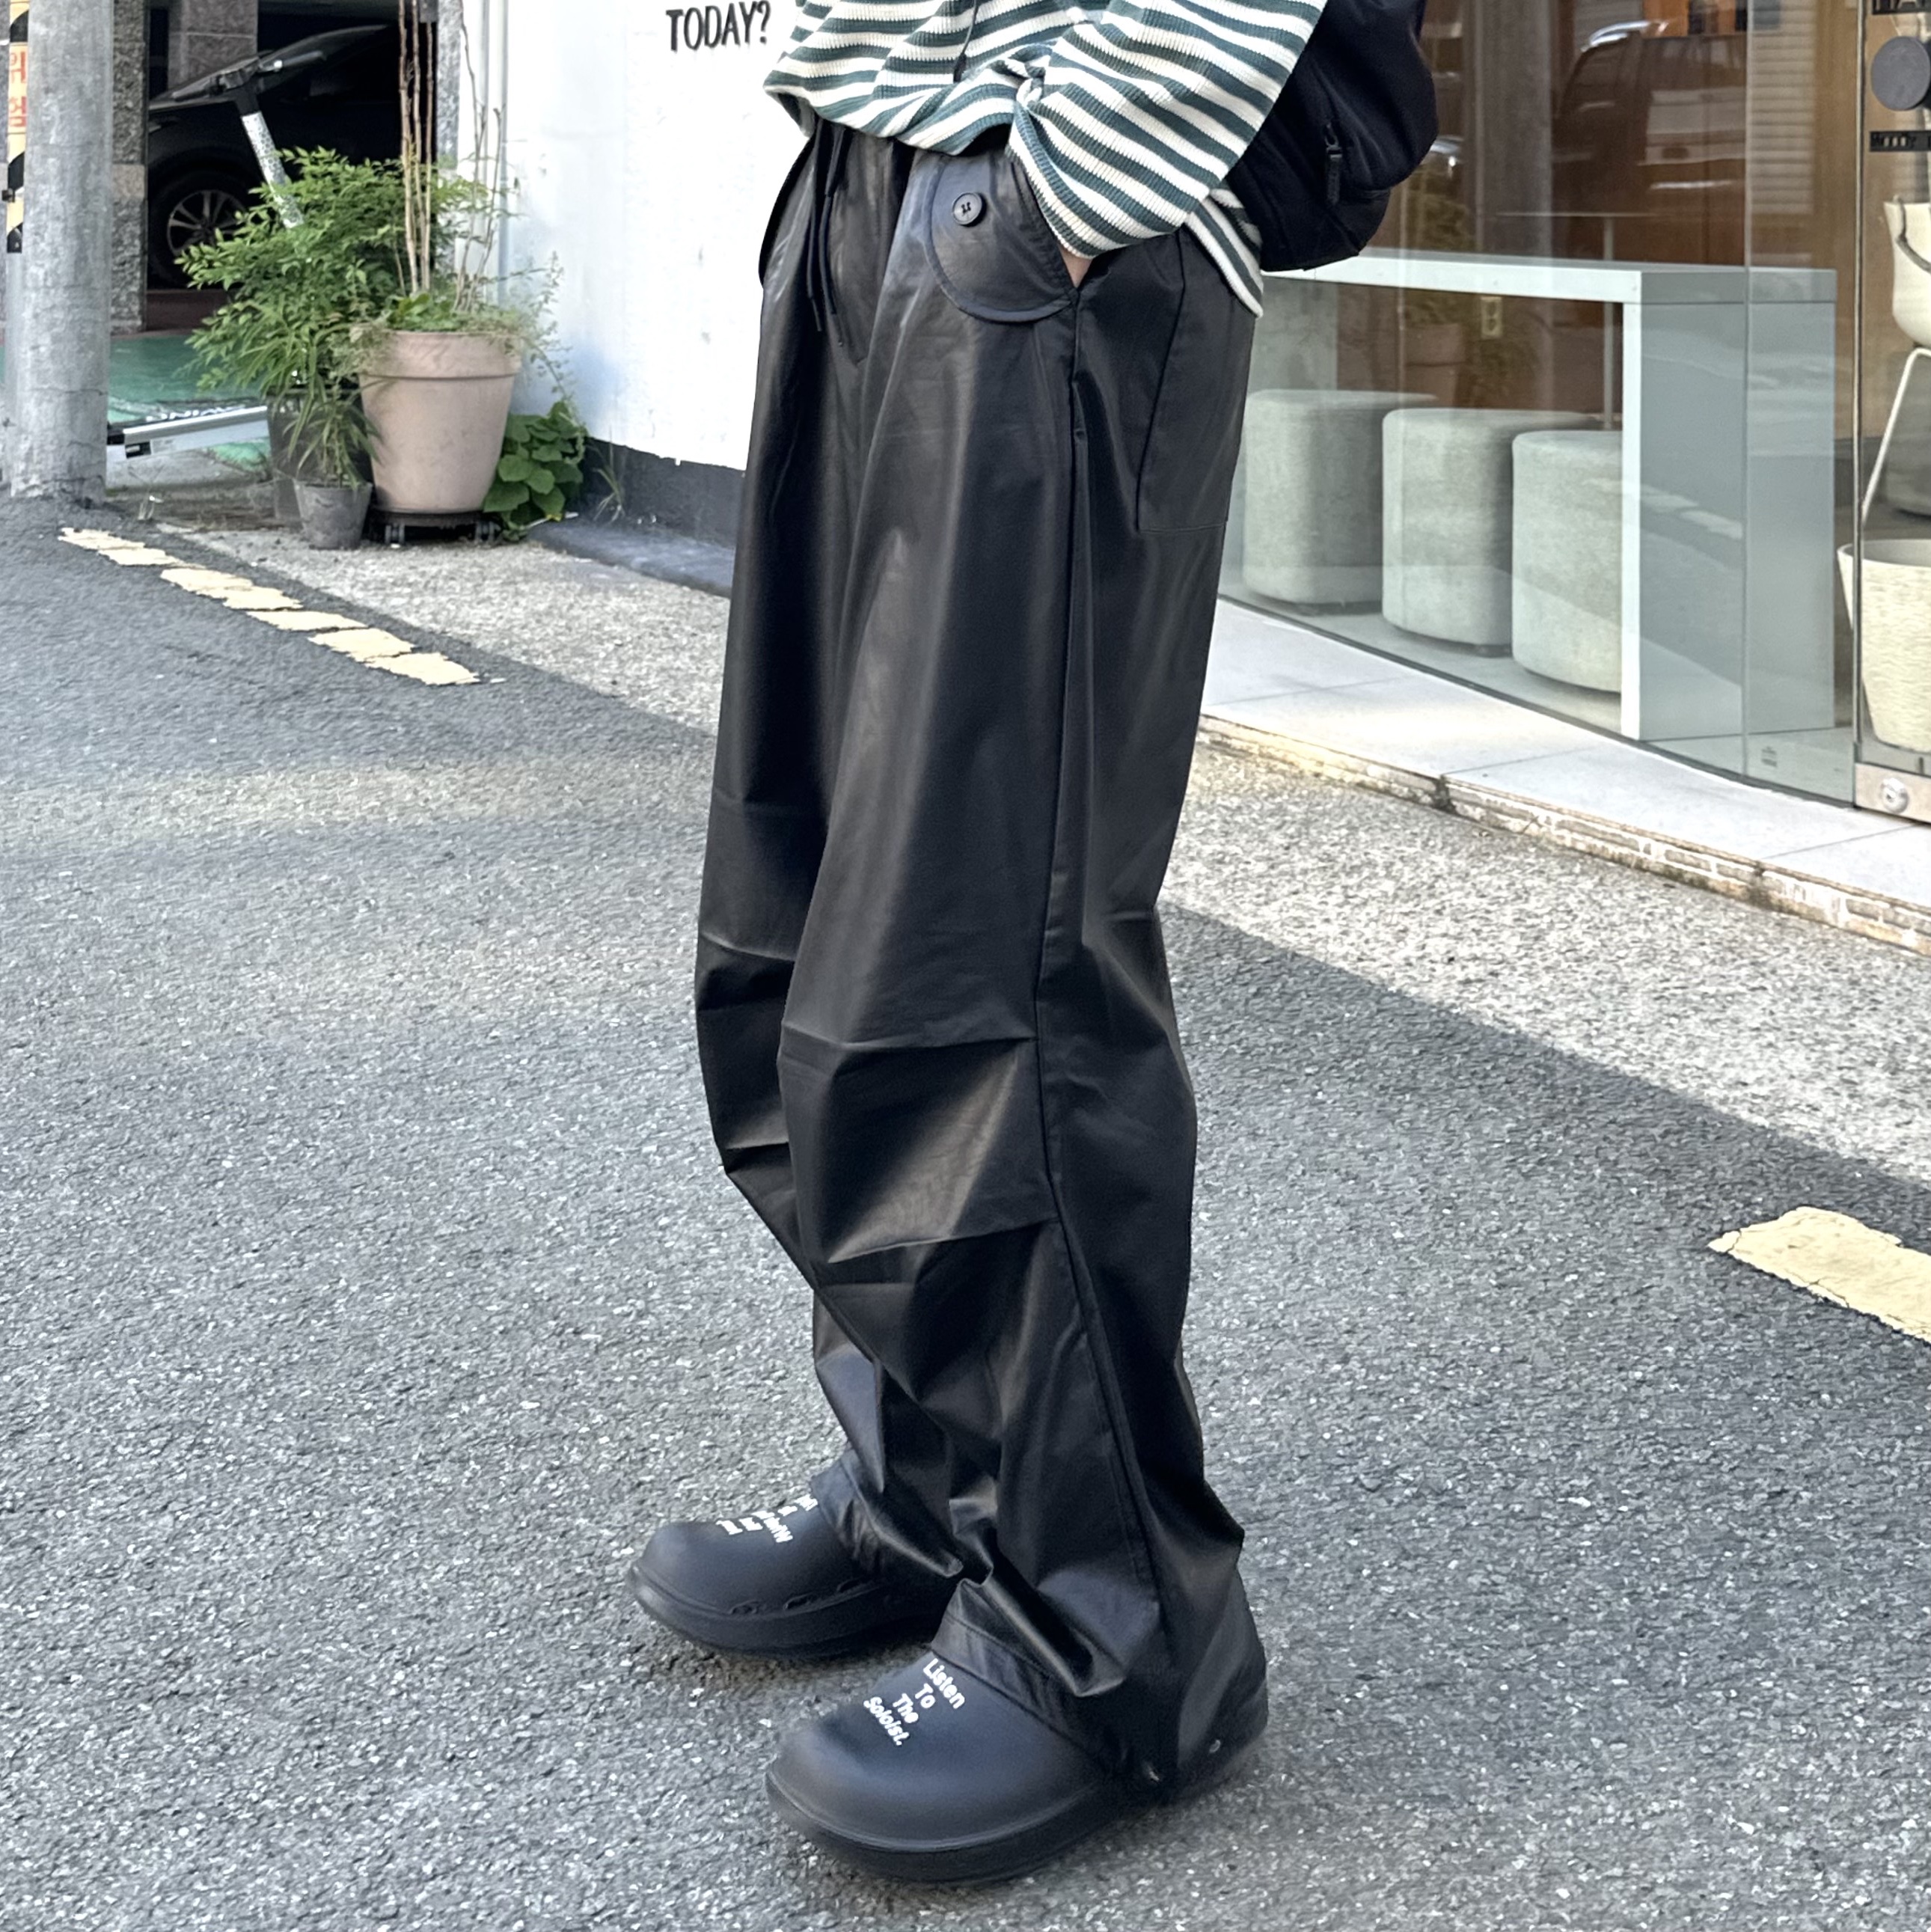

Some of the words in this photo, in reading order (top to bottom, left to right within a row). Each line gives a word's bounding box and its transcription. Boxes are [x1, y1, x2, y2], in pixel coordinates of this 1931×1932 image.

[666, 0, 771, 52] TODAY?
[915, 1683, 935, 1708] To
[923, 1657, 965, 1709] Listen
[893, 1693, 919, 1723] The
